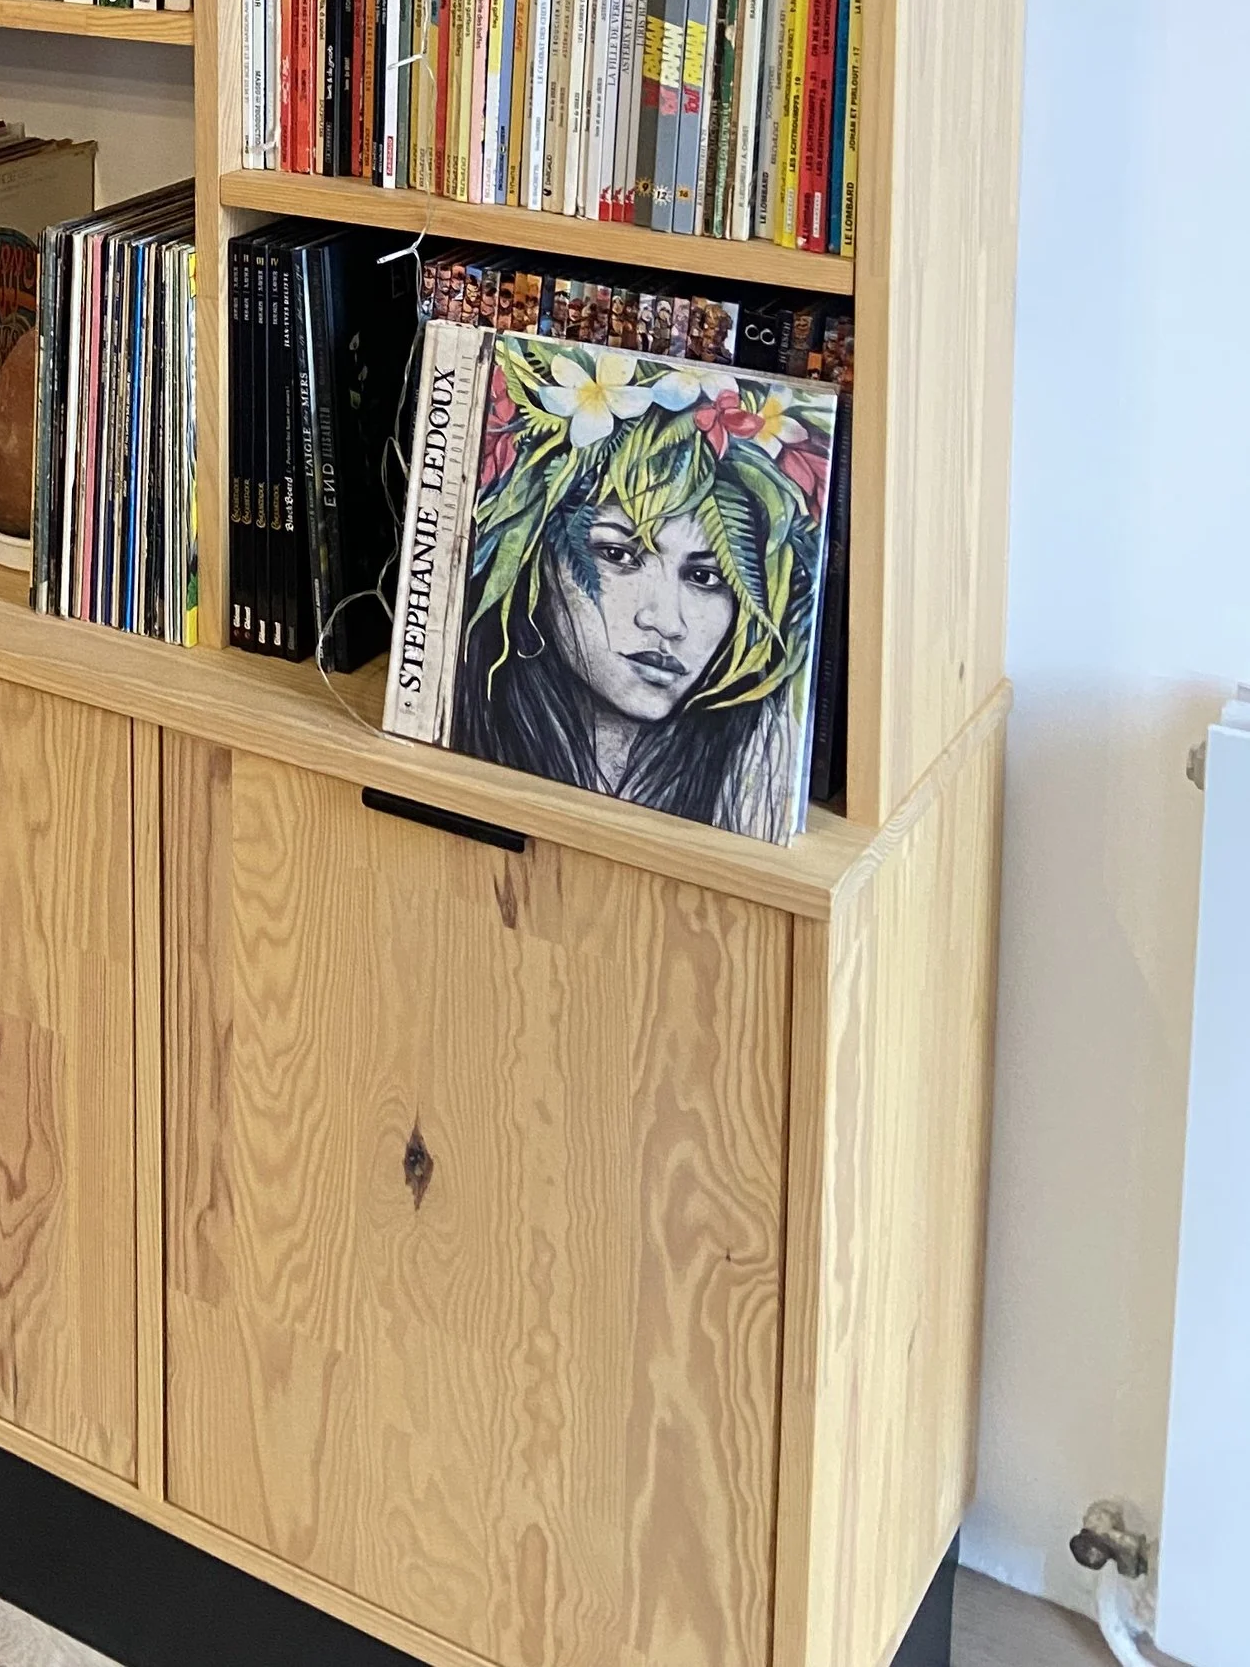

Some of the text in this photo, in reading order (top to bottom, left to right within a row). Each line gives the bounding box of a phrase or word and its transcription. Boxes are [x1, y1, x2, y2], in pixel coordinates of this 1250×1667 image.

[475, 27, 484, 49] baffes
[610, 26, 619, 40] DE
[621, 32, 632, 75] ASTERIX
[636, 19, 646, 47] L'IRIS
[608, 43, 618, 70] FILLE
[608, 72, 617, 86] LA
[790, 94, 800, 155] SCHTROUMPFS
[848, 65, 859, 151] JOHAN PIRLOUIT
[656, 191, 667, 200] 12
[761, 171, 770, 213] LOMBARD
[845, 182, 855, 246] LE LOMBARD
[299, 372, 314, 477] L'AIGLE MERS
[440, 354, 474, 533] TRAIT POUR TRAIT
[398, 365, 455, 694] STEPHANIE LEDOUX
